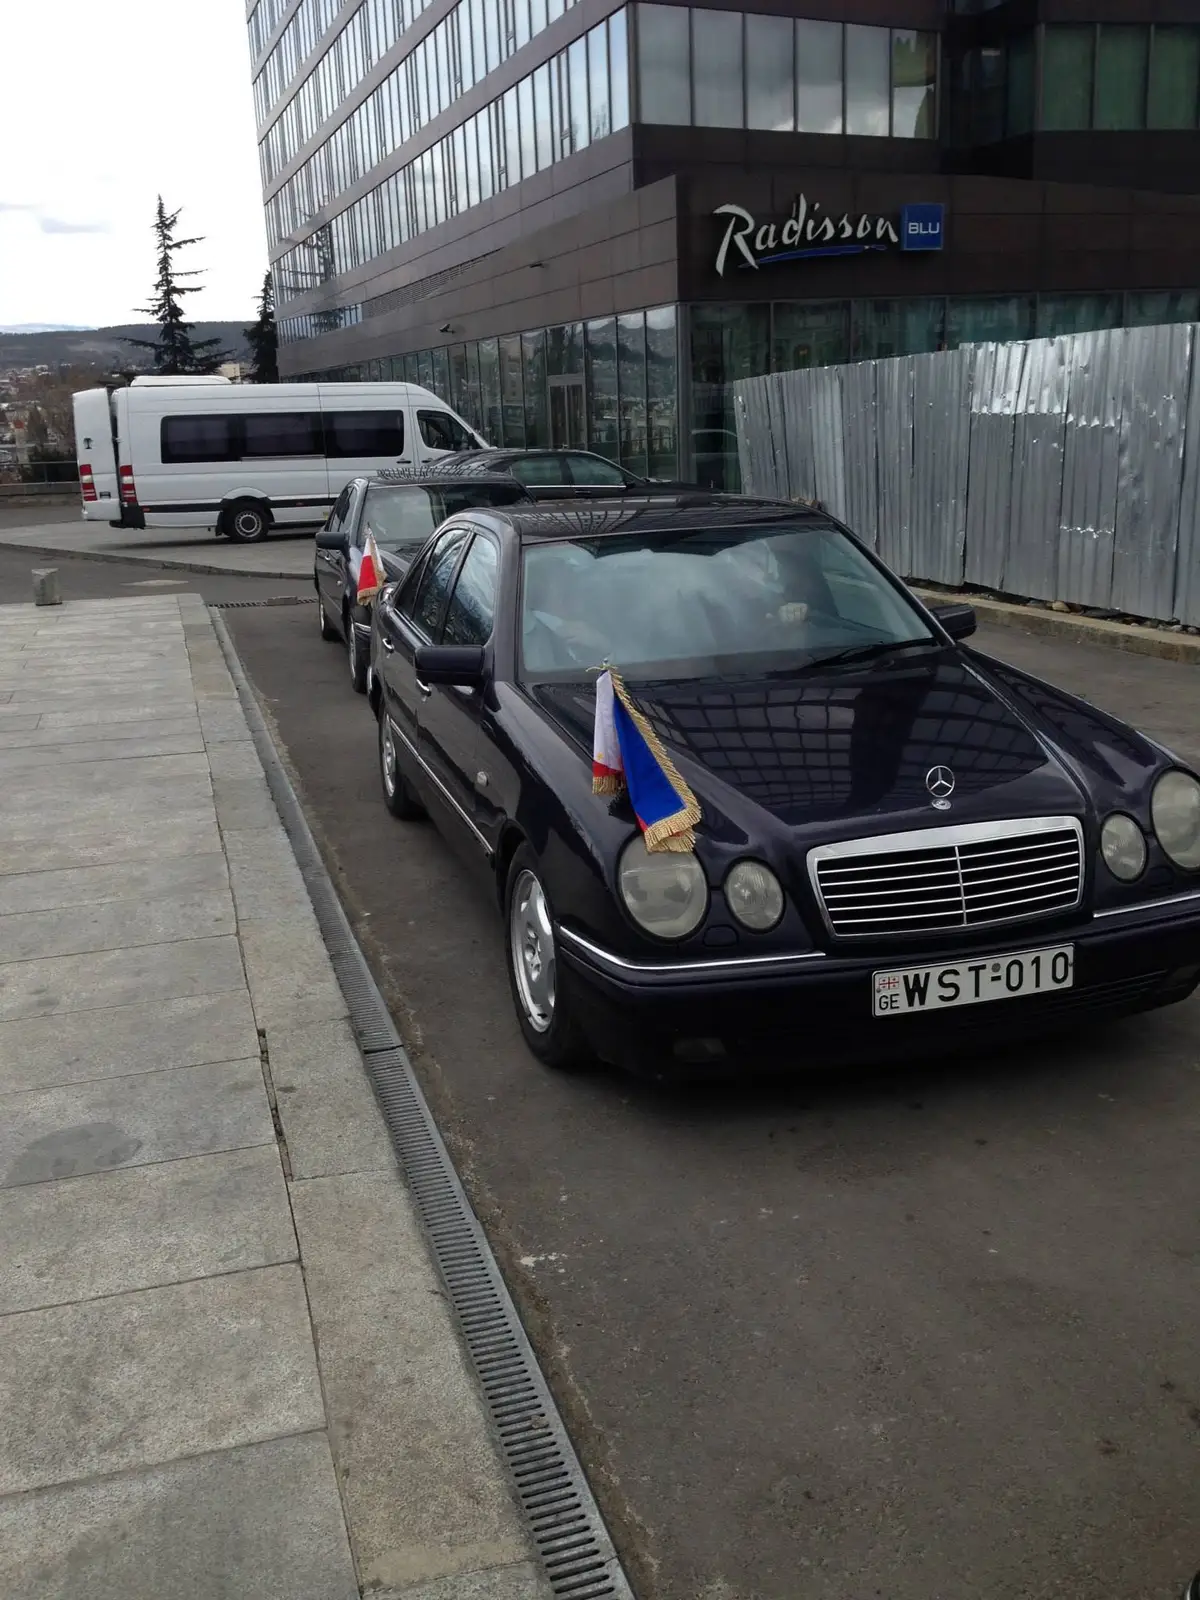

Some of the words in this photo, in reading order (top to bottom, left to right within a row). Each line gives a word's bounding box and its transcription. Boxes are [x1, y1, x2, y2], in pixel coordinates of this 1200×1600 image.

[713, 193, 899, 277] Radisson
[907, 222, 940, 235] BLU
[878, 993, 900, 1011] GE
[903, 952, 1069, 1008] WST-010
